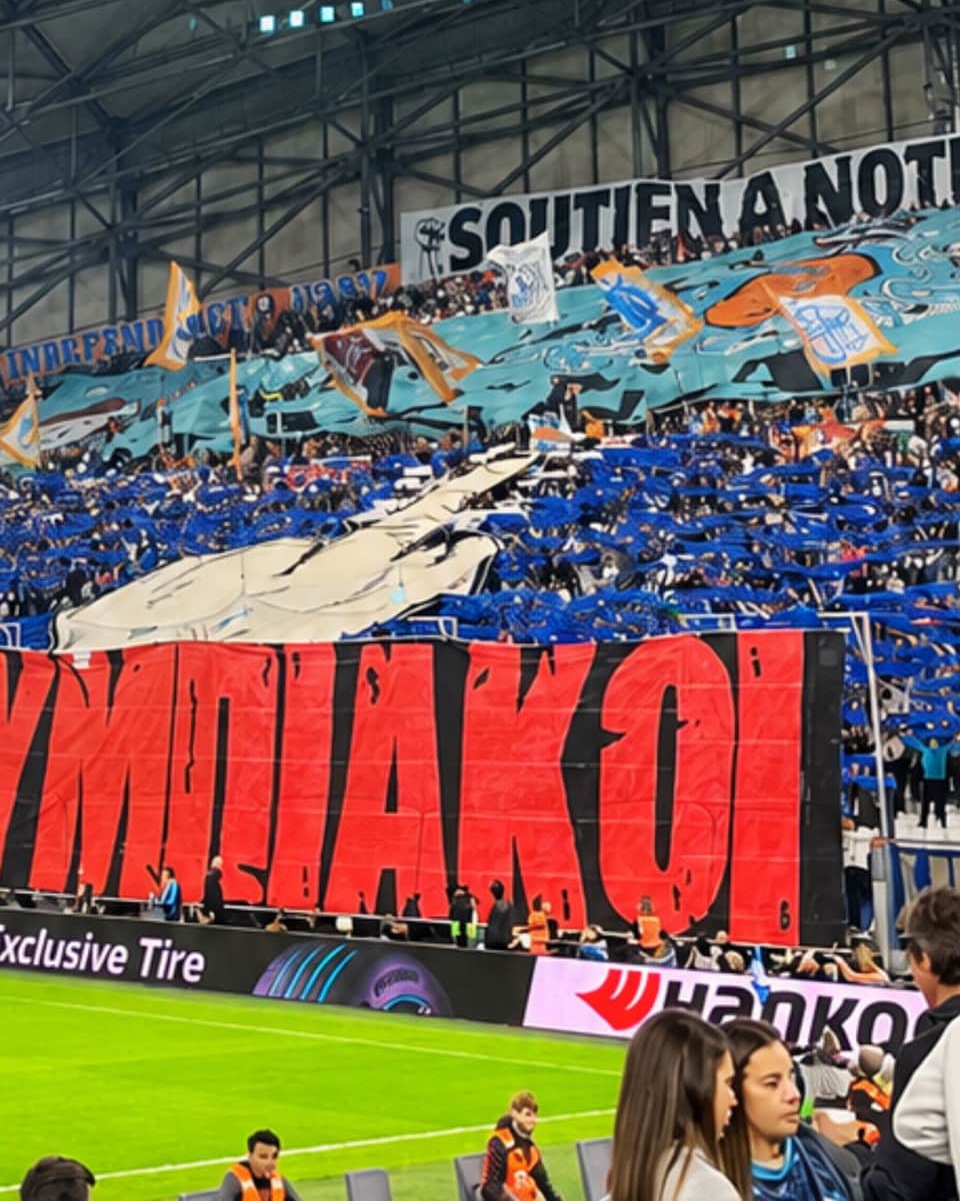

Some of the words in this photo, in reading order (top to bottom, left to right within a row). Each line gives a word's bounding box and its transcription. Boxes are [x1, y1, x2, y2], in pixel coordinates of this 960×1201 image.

[448, 181, 724, 272] SOUTIEN
[740, 171, 787, 235] A
[803, 138, 960, 230] NOT
[138, 938, 206, 983] Tire
